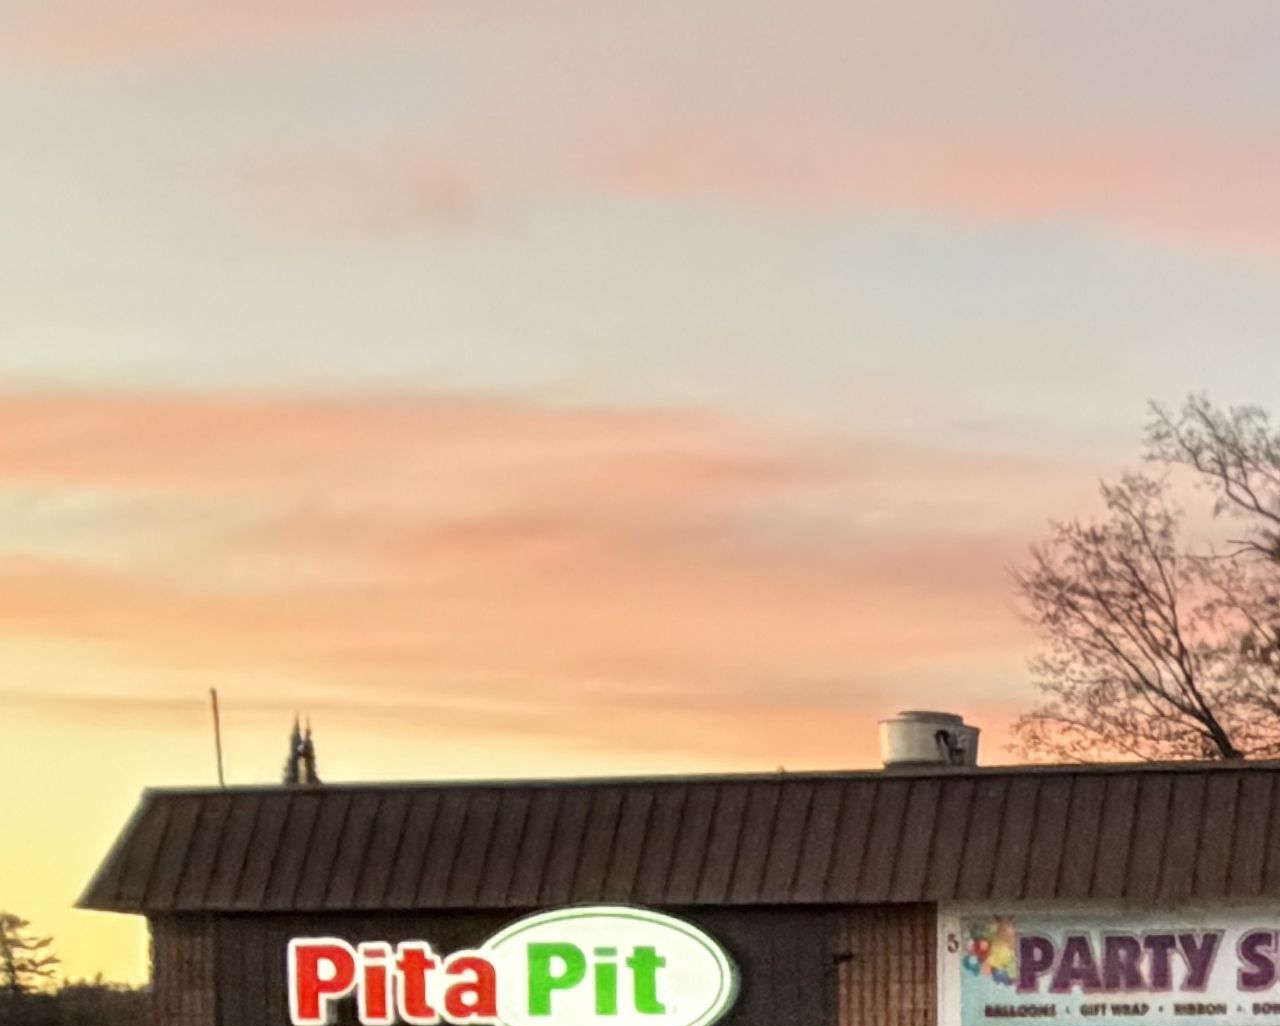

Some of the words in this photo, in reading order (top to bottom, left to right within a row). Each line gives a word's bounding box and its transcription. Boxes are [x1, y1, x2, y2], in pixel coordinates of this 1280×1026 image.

[292, 941, 499, 1020] Pita
[527, 941, 667, 1017] Pit
[1016, 928, 1225, 993] PARTY
[985, 1003, 1057, 1017] BALLOONS
[1080, 1003, 1106, 1017] GIFT
[1111, 1003, 1150, 1016] WRAP
[1174, 1003, 1227, 1016] RIBBON
